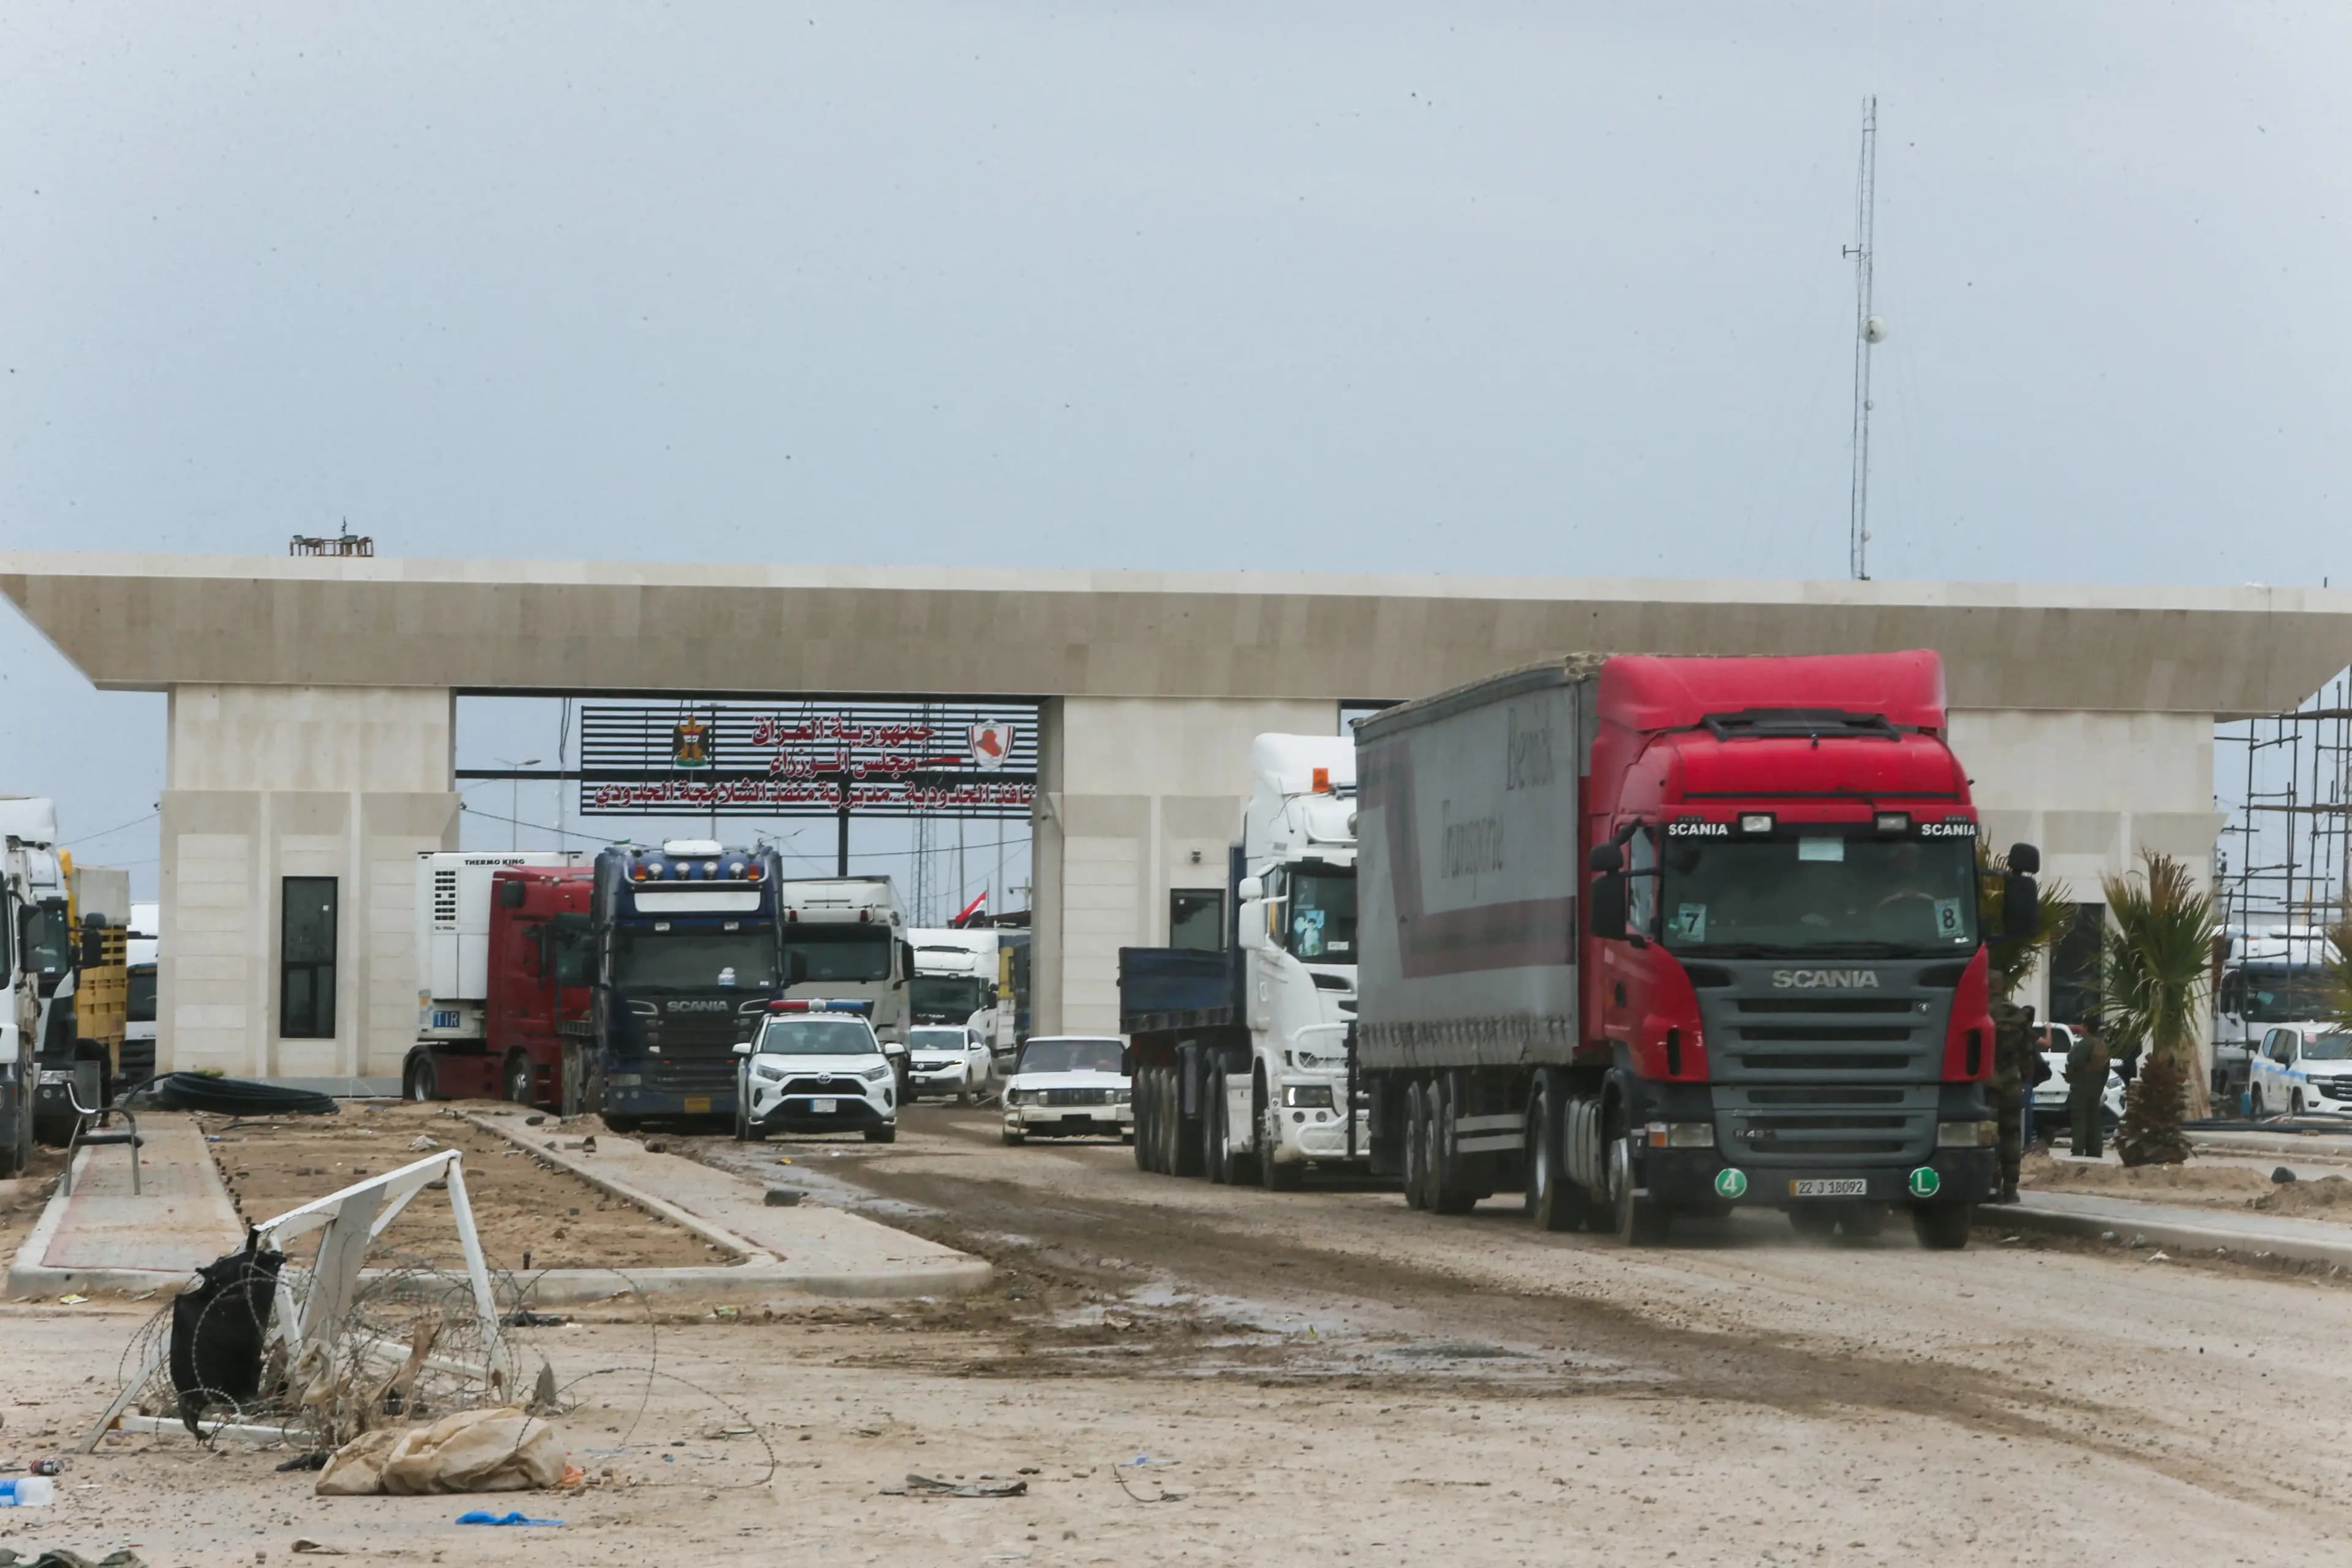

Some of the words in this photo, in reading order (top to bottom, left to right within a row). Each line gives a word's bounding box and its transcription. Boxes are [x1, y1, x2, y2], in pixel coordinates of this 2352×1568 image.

[752, 715, 824, 746] العراق
[830, 715, 937, 749] جمهورية
[770, 748, 850, 778] الوزراء
[853, 749, 918, 780] مجلس
[594, 780, 674, 809] الحدودي
[679, 777, 766, 809] الشلامجة
[770, 779, 815, 802] منفذ
[818, 780, 891, 809] مديرية
[904, 780, 990, 809] الحدودية
[994, 782, 1037, 804] نافذ
[1668, 823, 1728, 836] SCANIA
[1921, 823, 1976, 836] SCANIA
[1685, 913, 1700, 933] 7
[1942, 908, 1956, 929] 8
[1773, 970, 1880, 988] SCANIA
[666, 1000, 729, 1012] SCANIA
[435, 1011, 459, 1027] TIR
[1722, 1170, 1738, 1193] 4
[1798, 1182, 1812, 1194] 22
[1818, 1181, 1825, 1194] J
[1828, 1180, 1864, 1194] 18092
[1917, 1172, 1931, 1193] L
